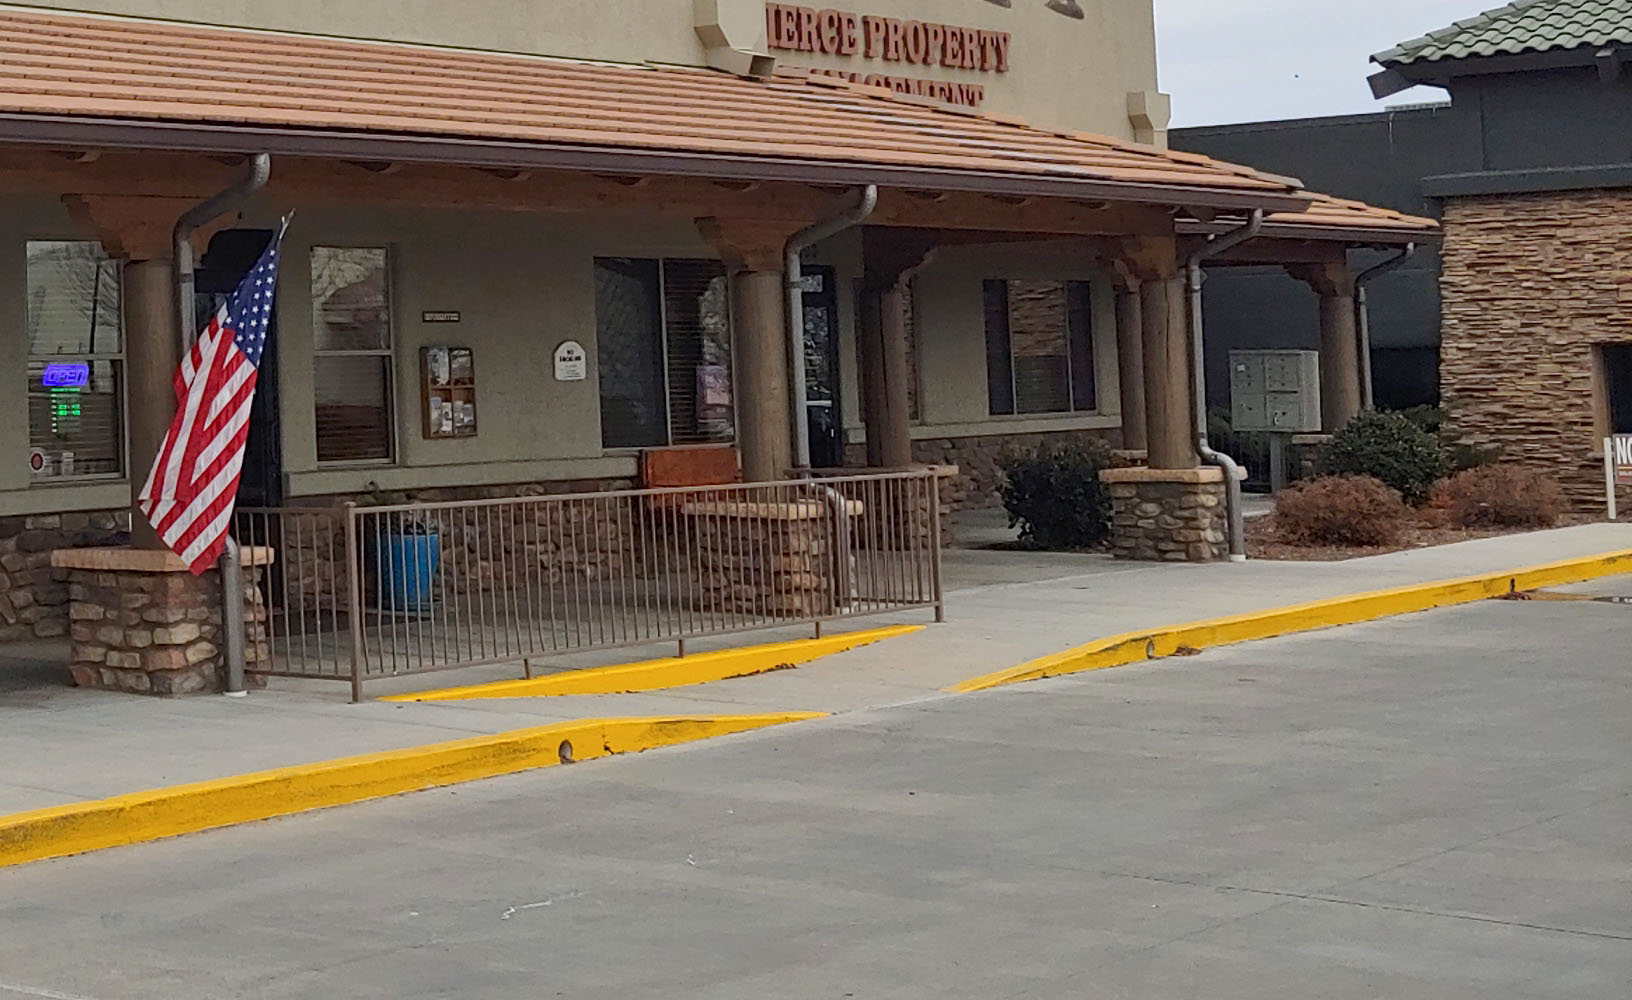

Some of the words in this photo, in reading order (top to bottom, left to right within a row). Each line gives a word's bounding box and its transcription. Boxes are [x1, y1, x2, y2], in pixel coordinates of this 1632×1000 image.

[766, 3, 857, 56] IERCE
[863, 15, 1011, 72] PROPERTY
[48, 369, 86, 383] OPEN
